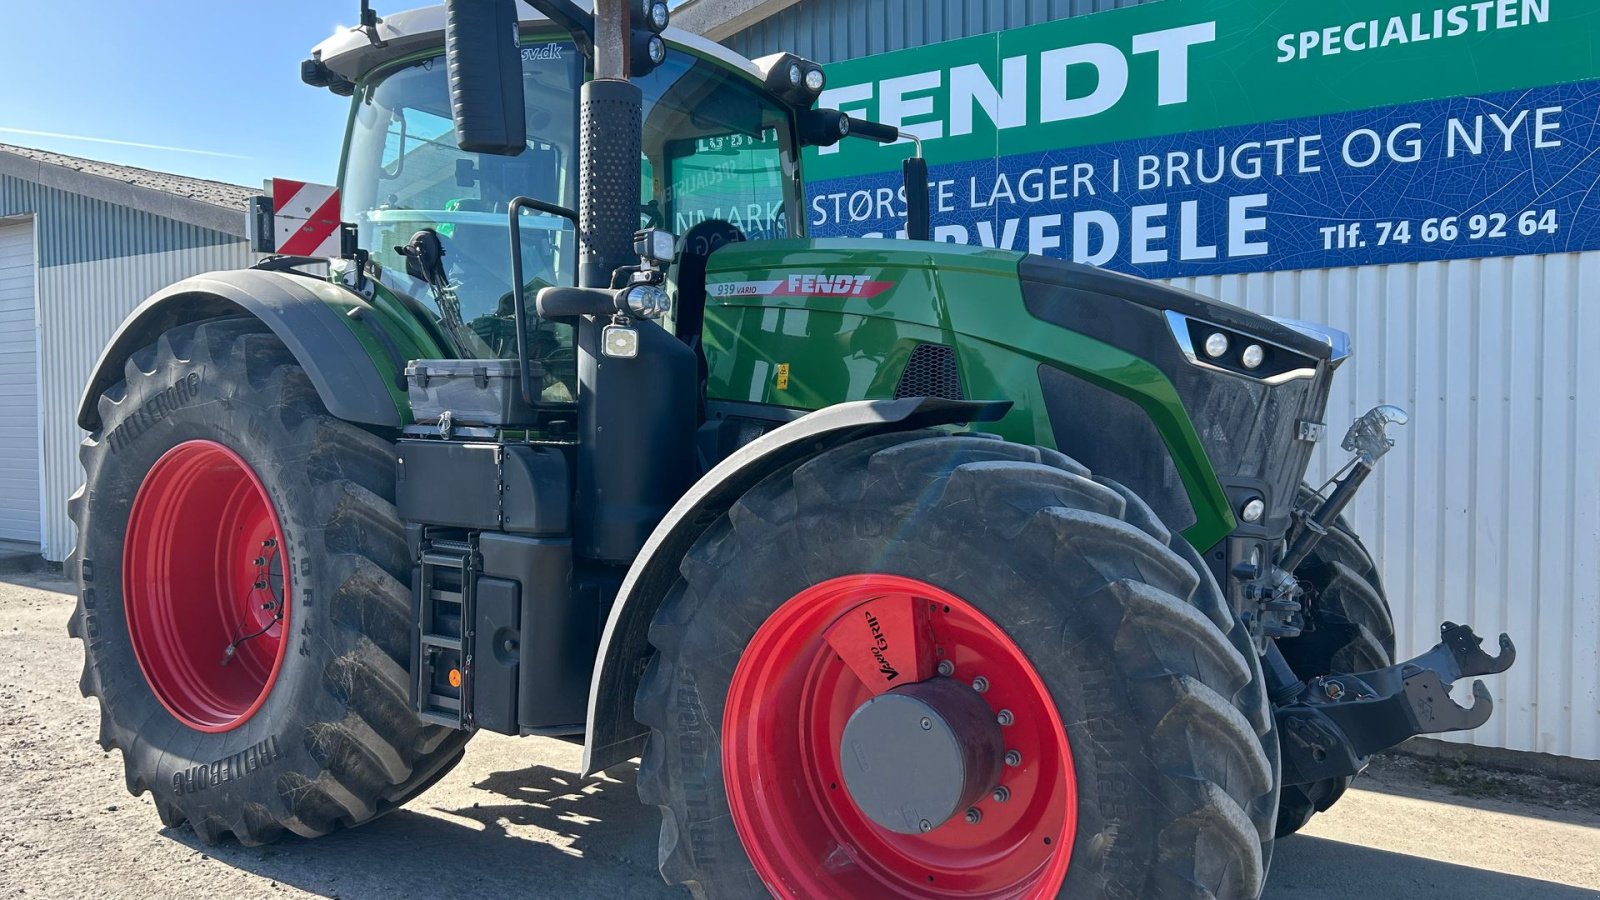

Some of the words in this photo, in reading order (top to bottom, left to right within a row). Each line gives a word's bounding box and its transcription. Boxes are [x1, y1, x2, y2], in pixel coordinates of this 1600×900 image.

[1277, 0, 1549, 63] SPECIALISTEN
[818, 20, 1216, 156] FENDT
[970, 163, 1096, 209] LAGER
[1113, 158, 1120, 193] I
[1137, 134, 1321, 190] BRUGTE
[1341, 122, 1422, 168] OG
[1446, 105, 1564, 158] NYE
[1319, 223, 1367, 250] Tlf.
[1375, 221, 1411, 246] 74
[1420, 216, 1459, 243] 66
[1468, 212, 1507, 241] 92
[1517, 208, 1559, 237] 64
[717, 284, 735, 296] 939
[736, 285, 757, 294] VARIO
[788, 274, 871, 295] FENDT
[106, 371, 201, 455] TRELLEBORG
[864, 611, 888, 652] GRIP
[173, 734, 282, 797] TRELLEBORG
